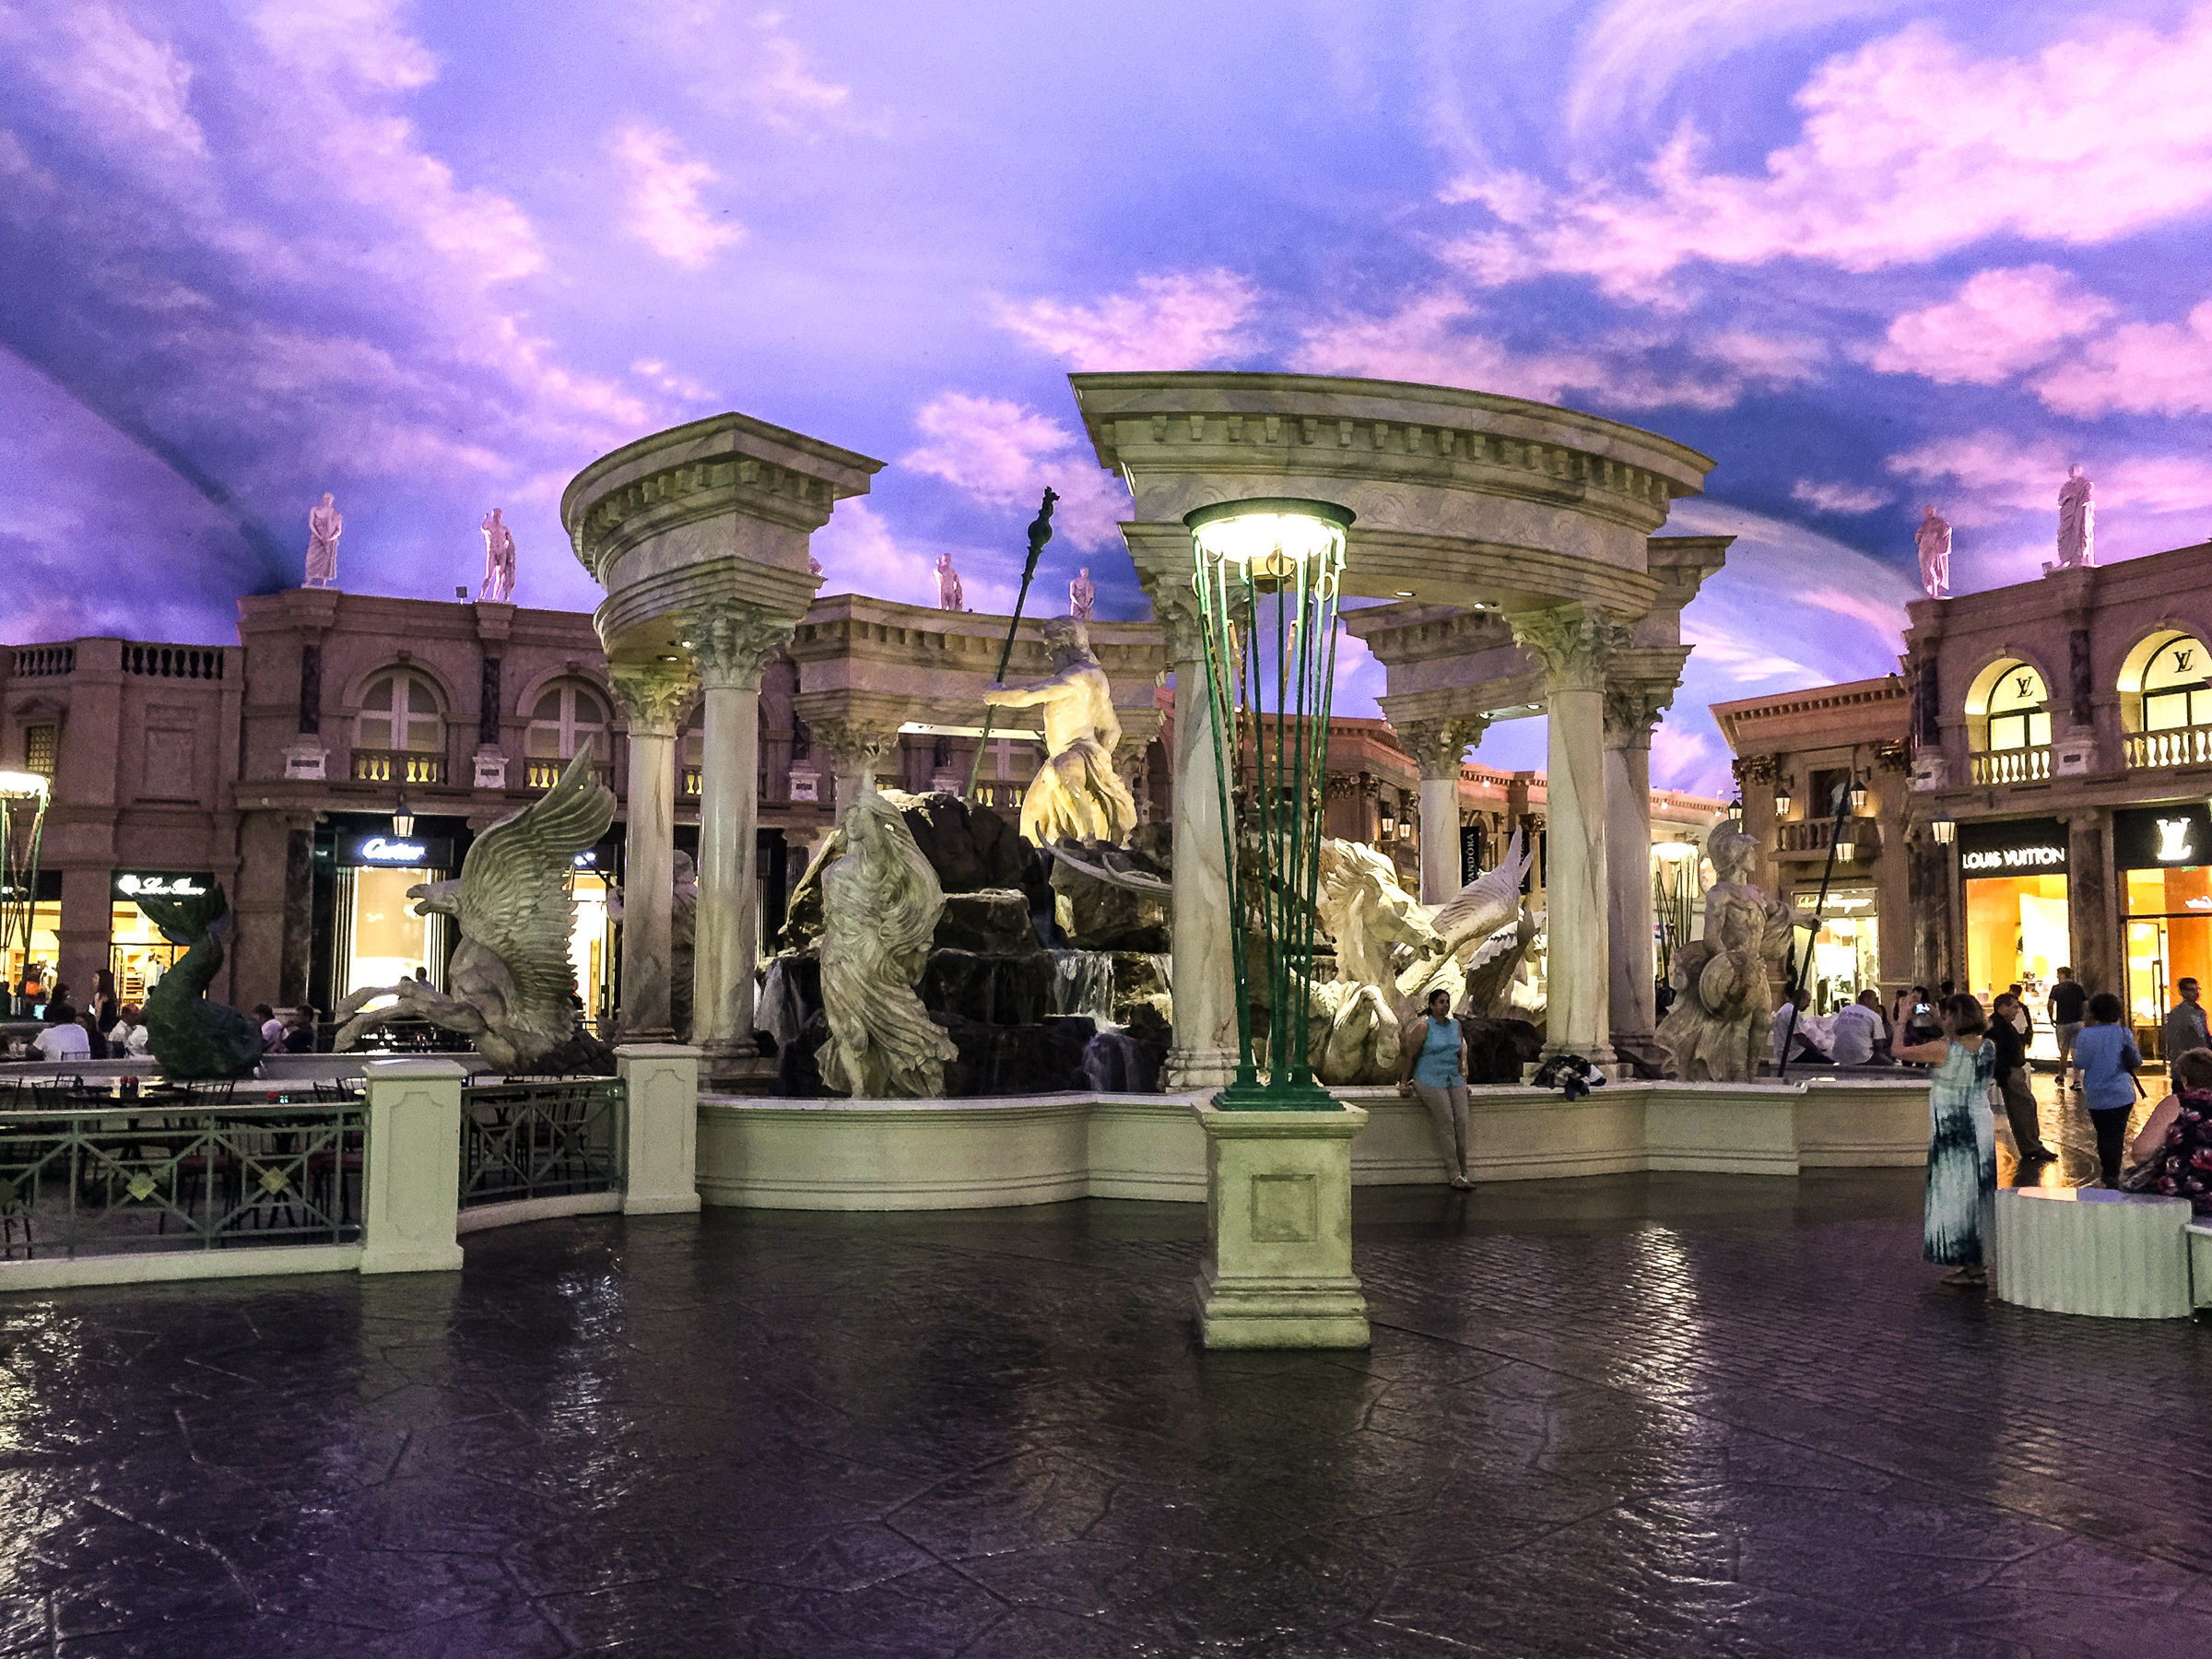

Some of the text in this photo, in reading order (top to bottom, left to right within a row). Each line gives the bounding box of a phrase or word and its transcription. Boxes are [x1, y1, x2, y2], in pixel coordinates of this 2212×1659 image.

[2173, 649, 2194, 674] LV
[2016, 676, 2033, 698] LV
[1962, 847, 2065, 869] LOUIS VUITTON
